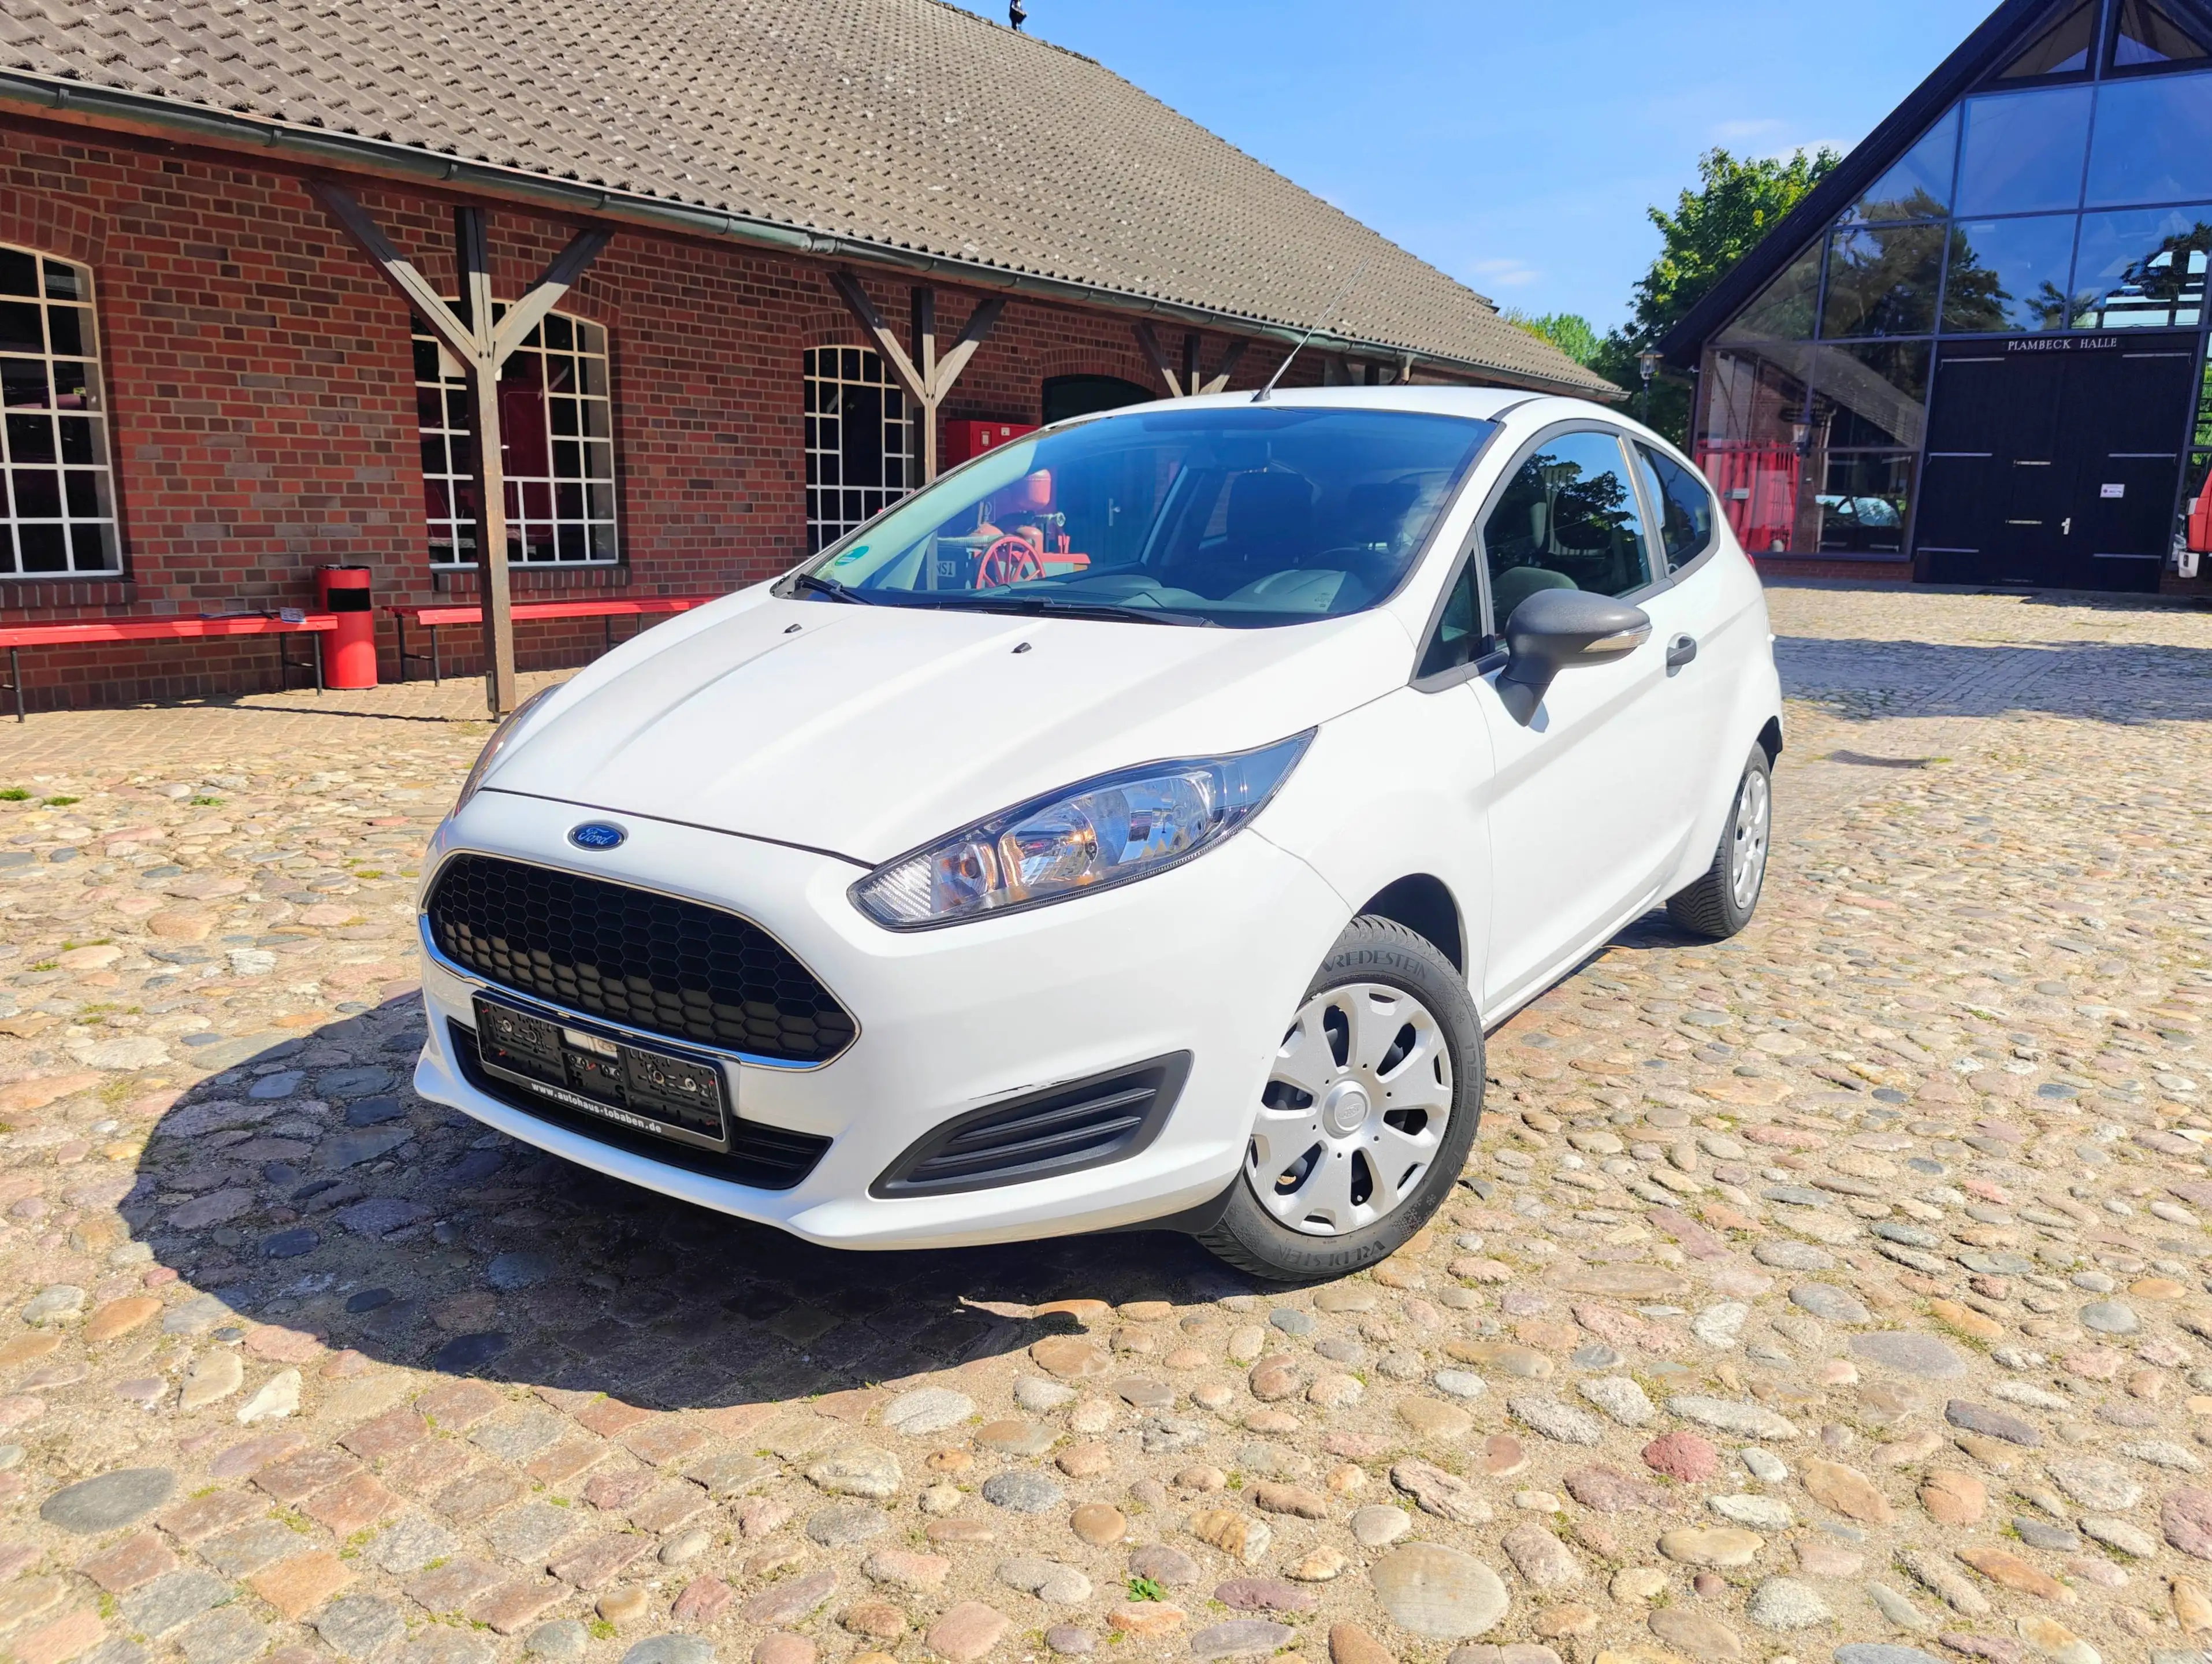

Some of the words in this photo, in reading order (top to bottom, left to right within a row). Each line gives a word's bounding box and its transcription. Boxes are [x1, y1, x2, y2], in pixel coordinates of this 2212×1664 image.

[2007, 339, 2072, 351] PLAMBECK
[2080, 337, 2117, 349] HALLE
[578, 827, 614, 845] Ford
[1321, 949, 1429, 982] VREDESTEIN
[531, 1082, 661, 1133] www.autohaus-tobaben.de
